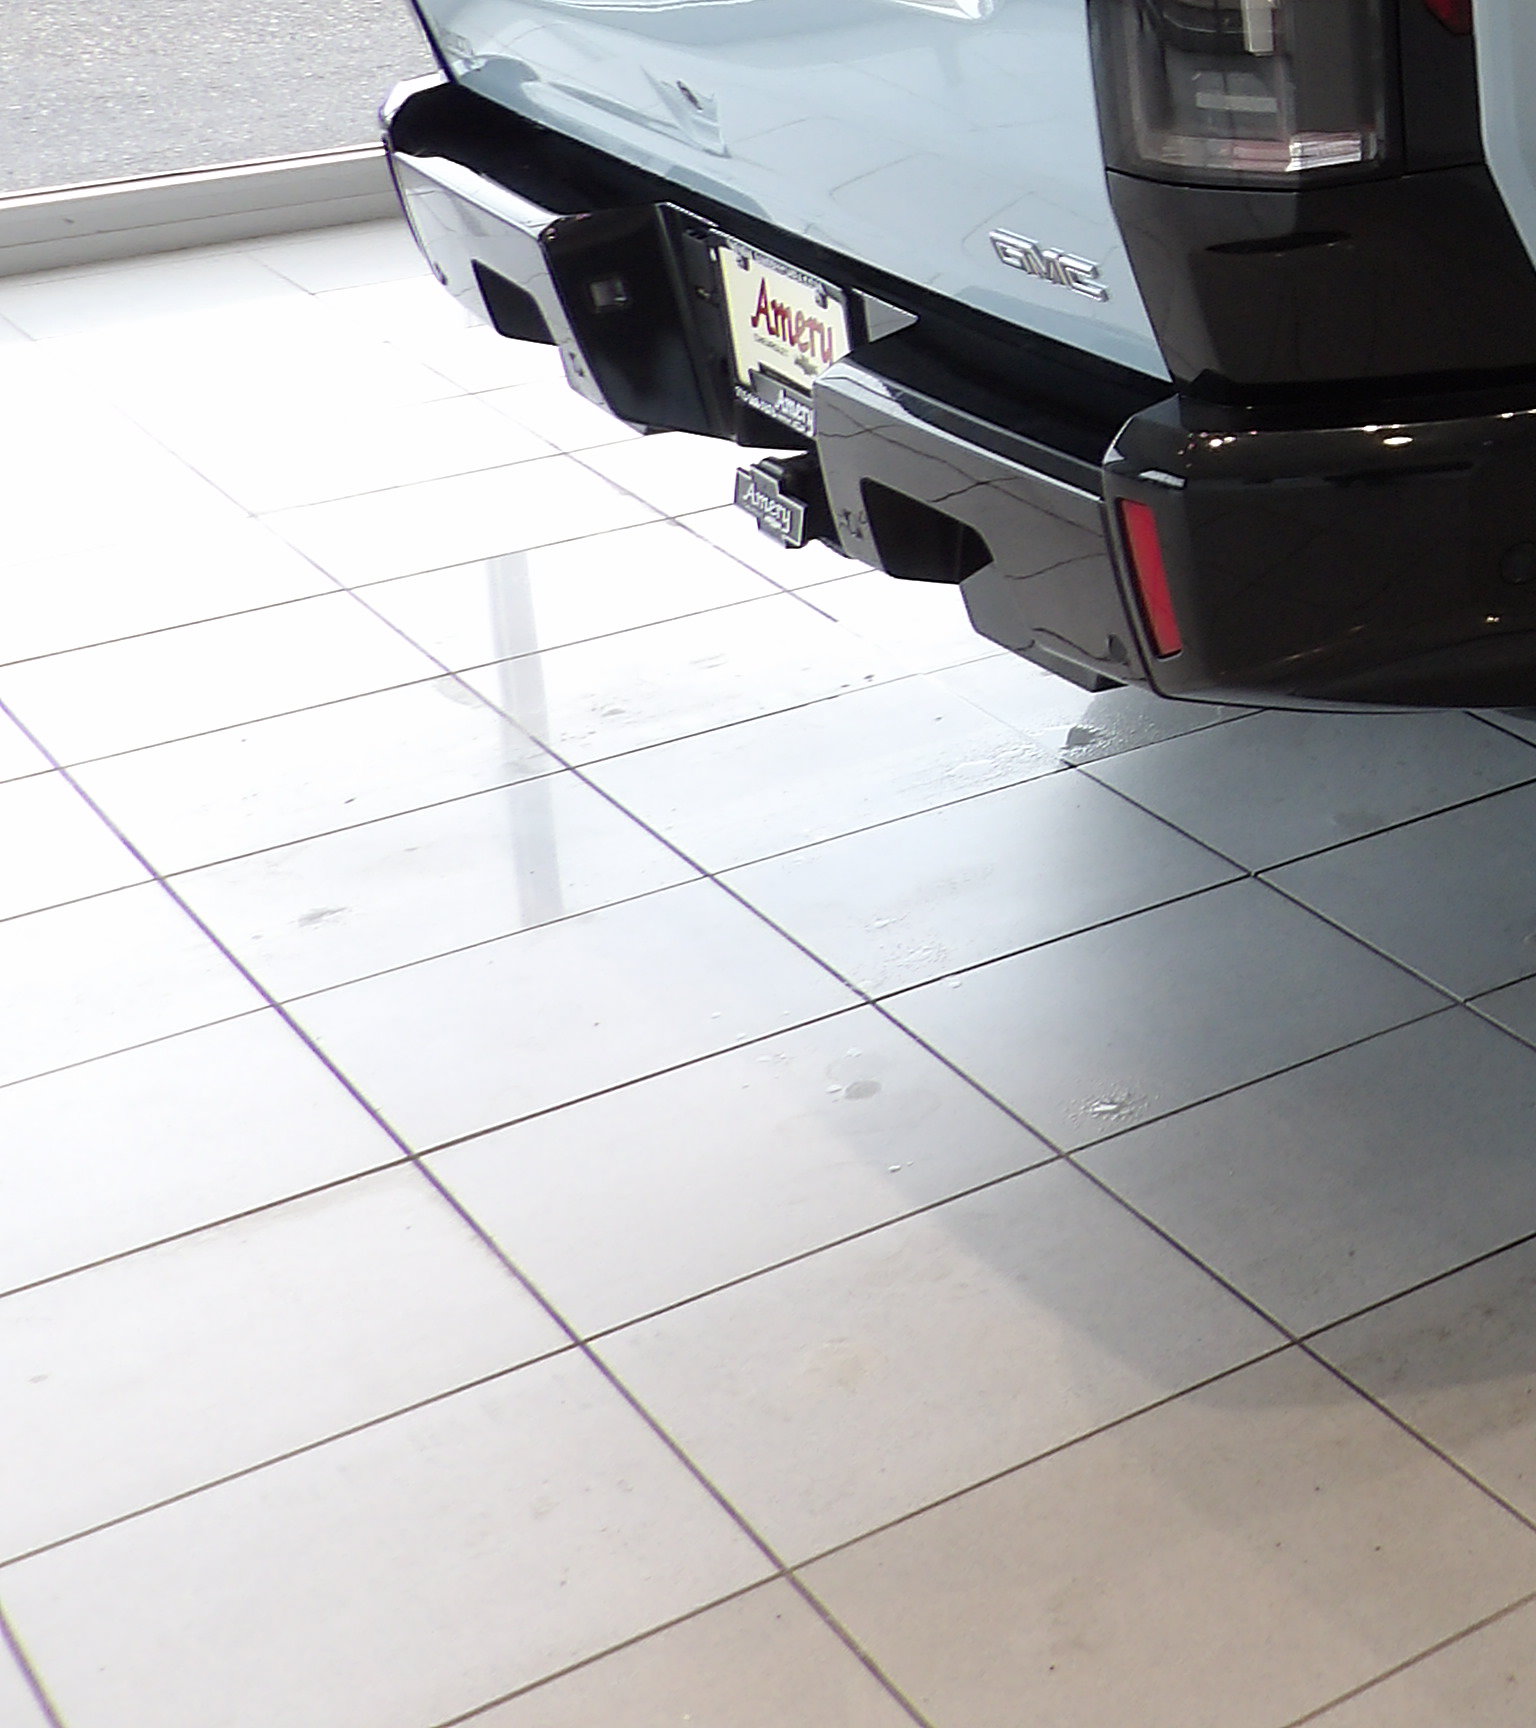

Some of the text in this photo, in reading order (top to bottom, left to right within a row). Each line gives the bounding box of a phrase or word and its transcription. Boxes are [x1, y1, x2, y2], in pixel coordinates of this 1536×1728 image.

[988, 228, 1110, 303] GMC
[751, 277, 834, 367] Amery
[743, 482, 792, 534] Amery
